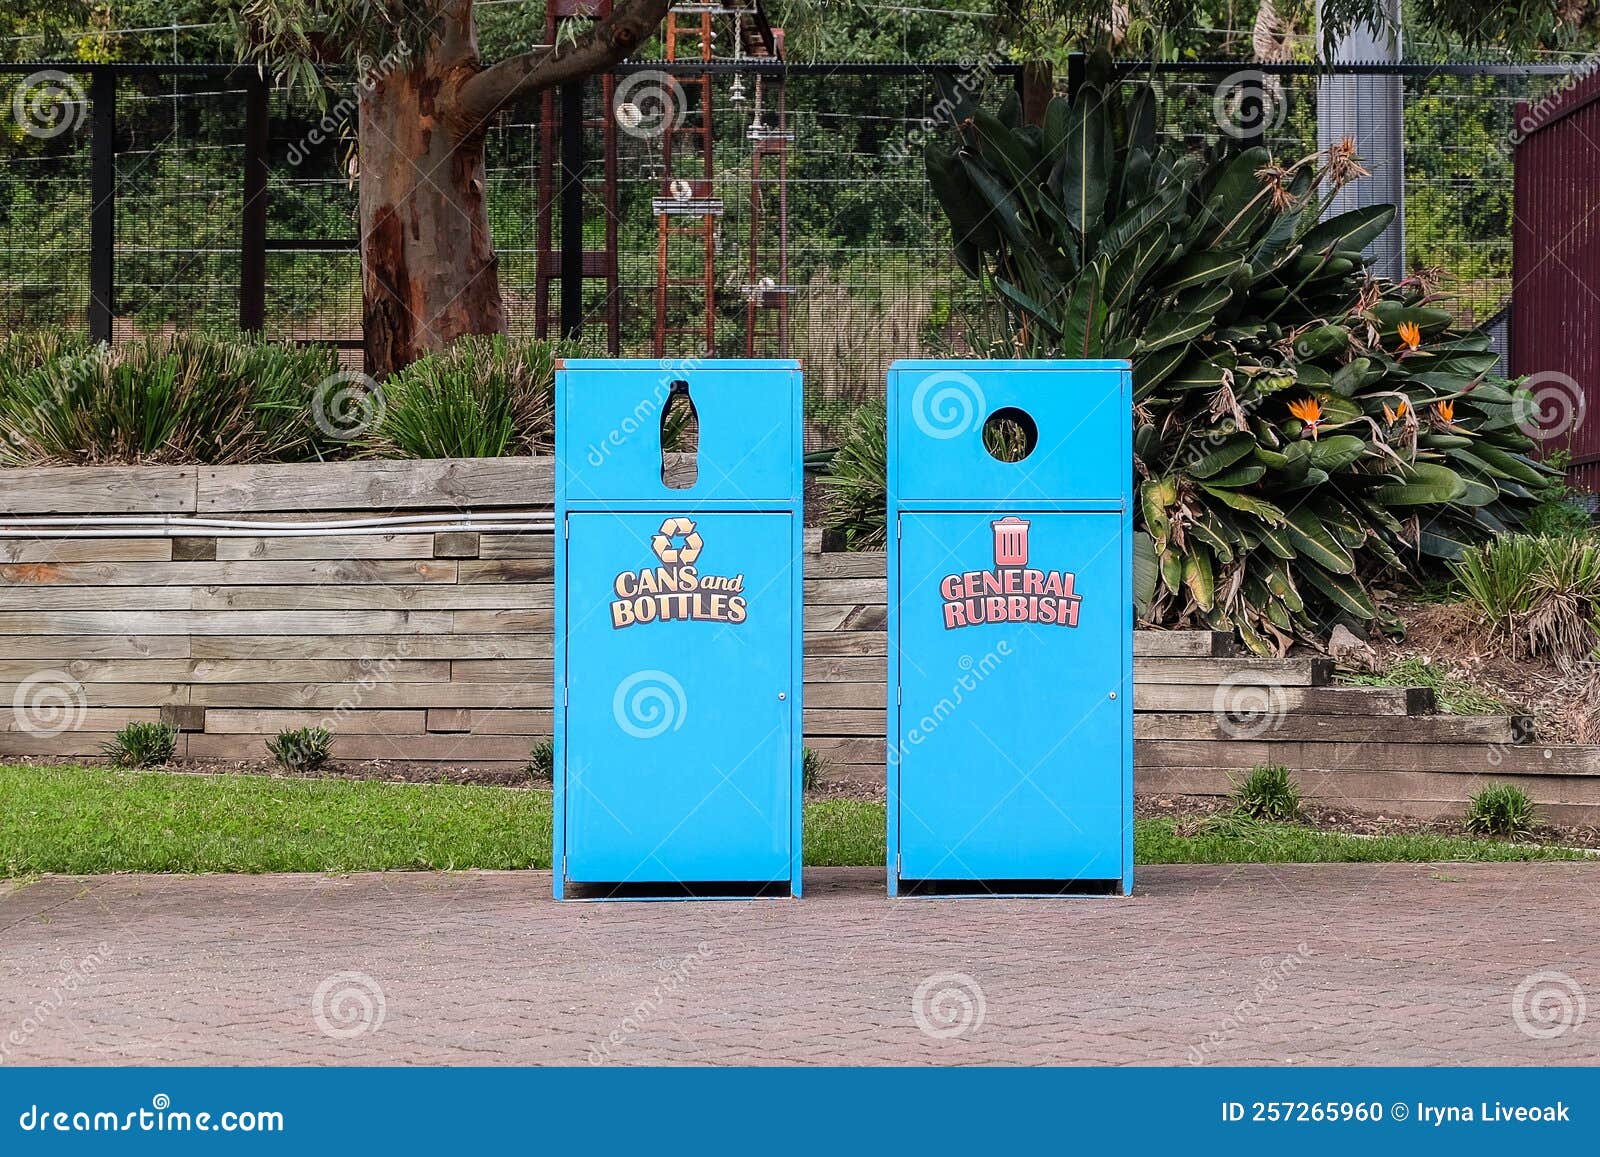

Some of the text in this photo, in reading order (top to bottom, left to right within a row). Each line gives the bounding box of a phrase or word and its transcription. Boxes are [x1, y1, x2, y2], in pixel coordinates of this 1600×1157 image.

[614, 565, 744, 598] CANS and
[940, 568, 1082, 601] GENERAL
[611, 592, 747, 628] BOTTLES
[943, 595, 1080, 629] RUBBISH
